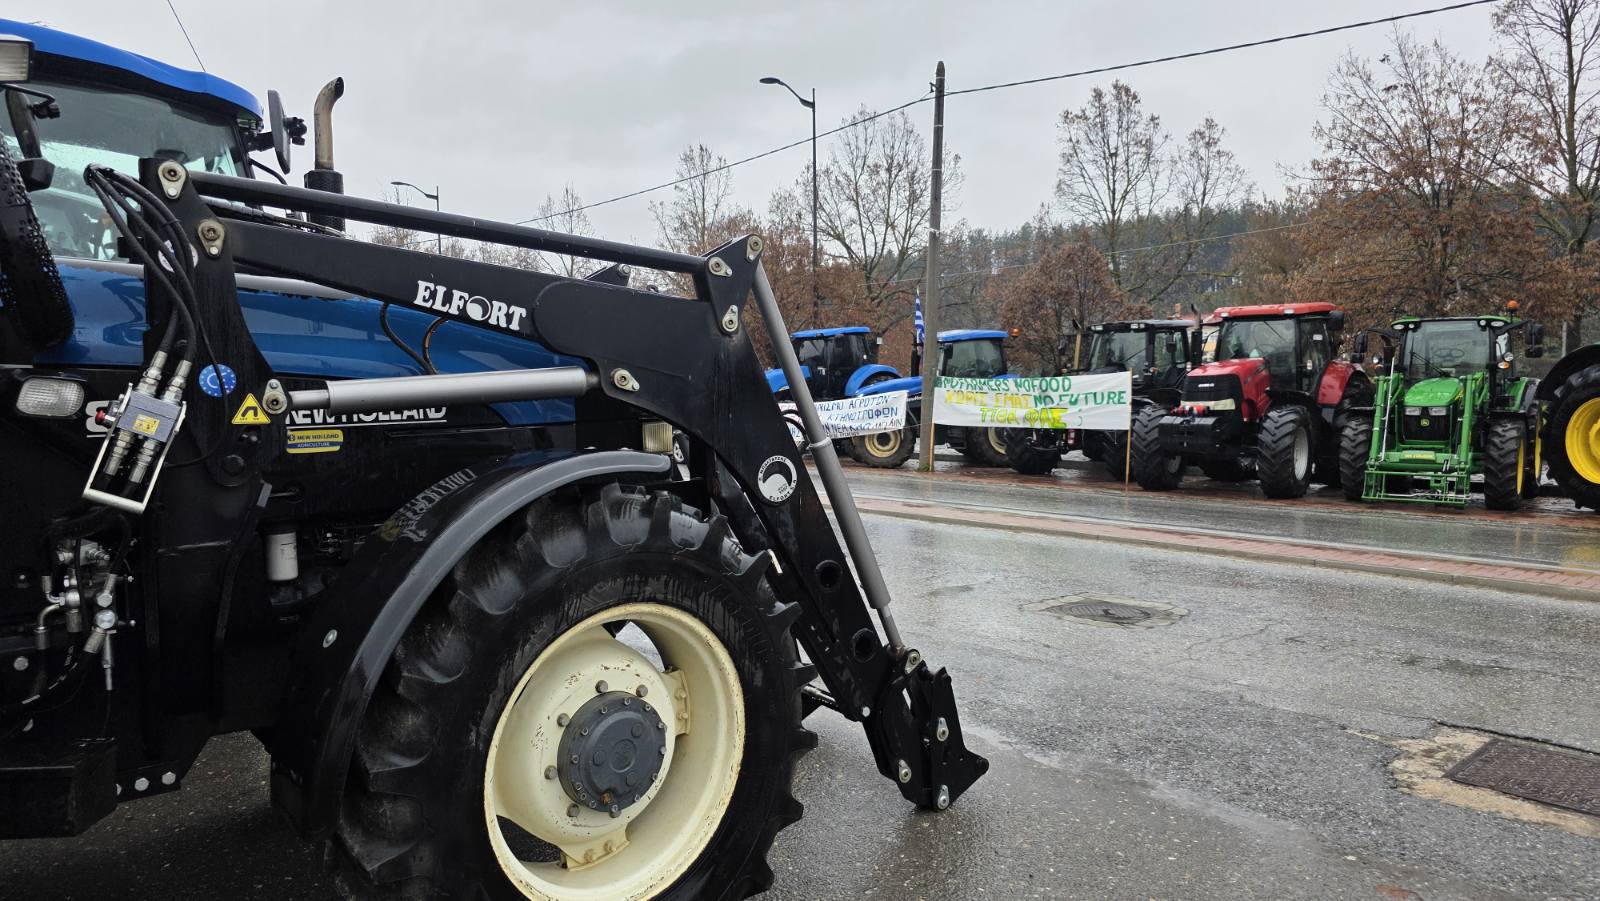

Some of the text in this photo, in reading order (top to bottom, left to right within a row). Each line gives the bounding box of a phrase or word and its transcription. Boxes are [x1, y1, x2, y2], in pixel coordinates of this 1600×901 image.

[413, 280, 527, 331] ELFORT
[285, 408, 335, 425] NEW
[312, 433, 339, 441] HOLLAND
